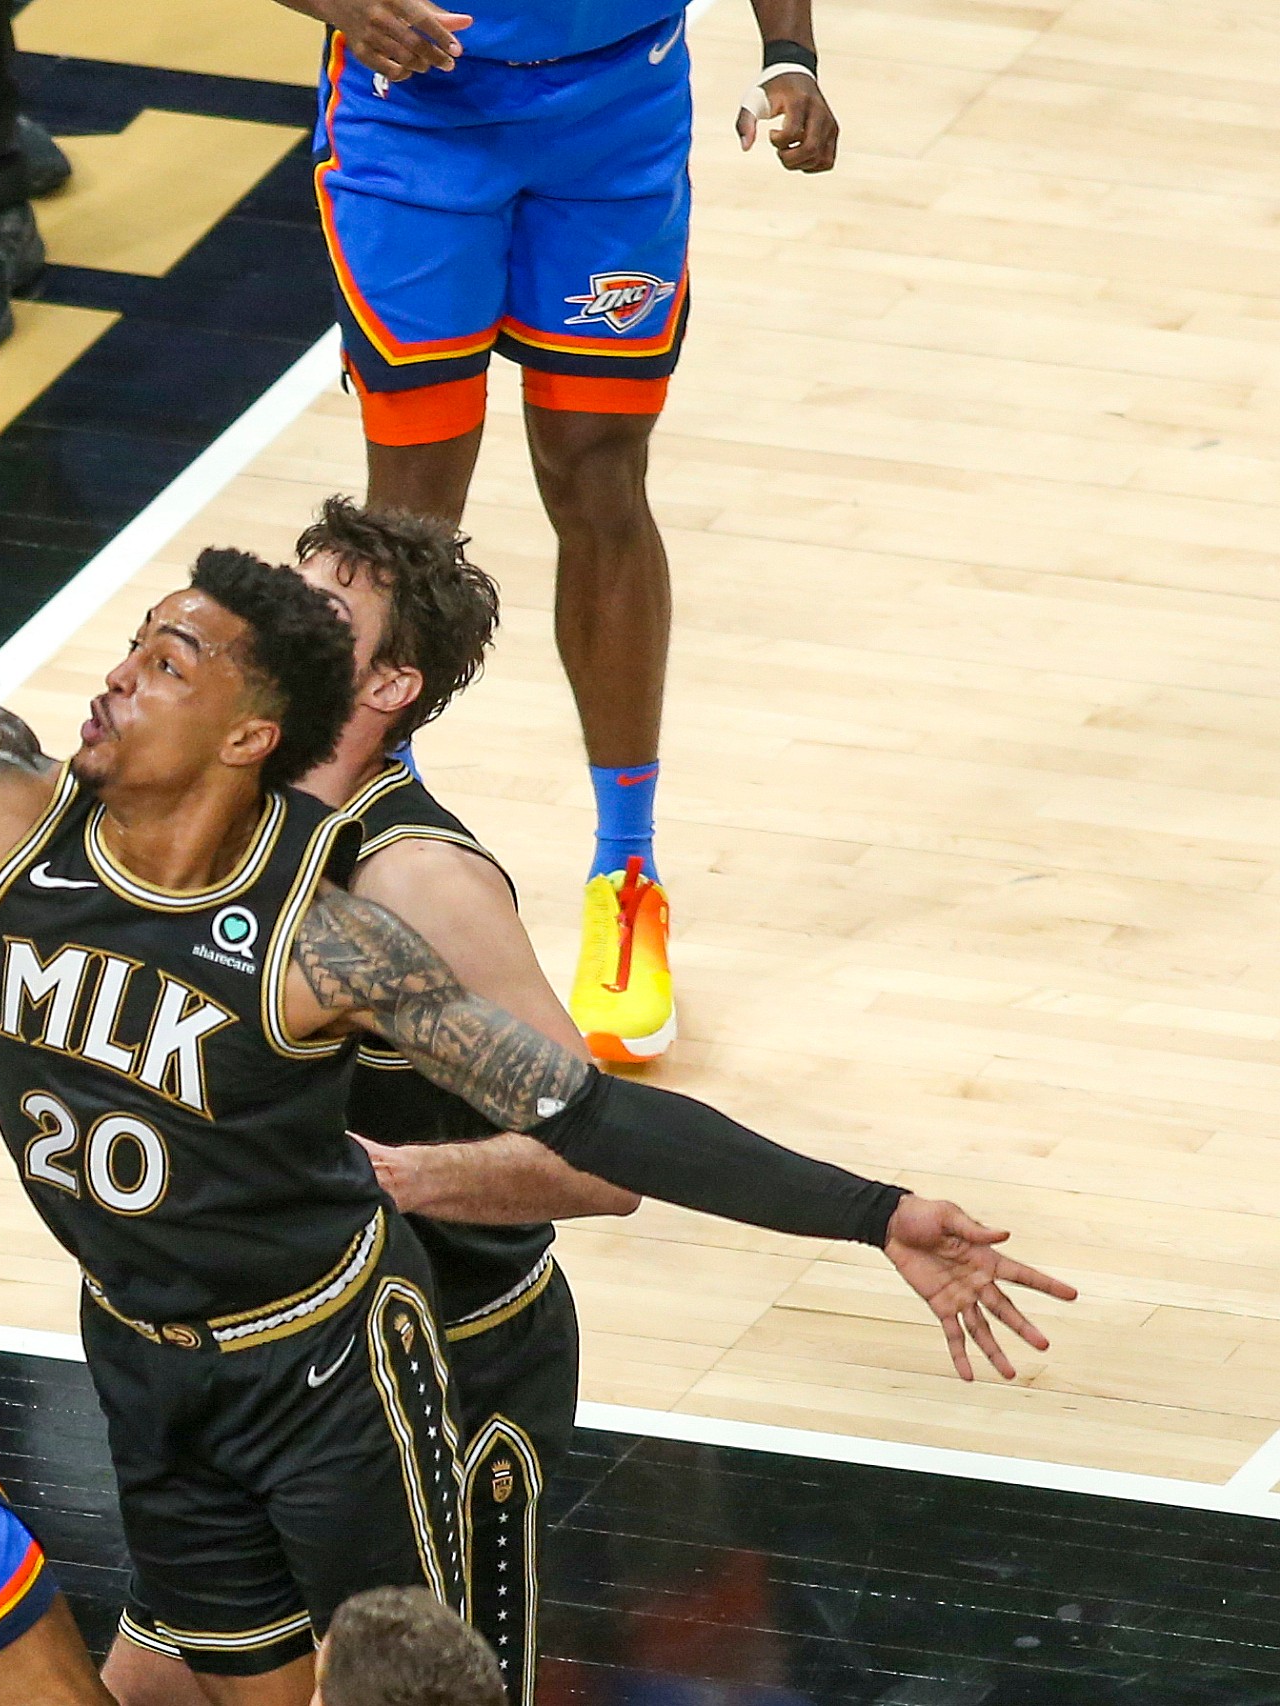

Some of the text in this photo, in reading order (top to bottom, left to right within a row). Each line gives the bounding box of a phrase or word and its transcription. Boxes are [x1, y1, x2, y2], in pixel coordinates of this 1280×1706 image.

[586, 285, 648, 314] OKC
[192, 944, 257, 975] sharecare
[20, 1089, 170, 1217] 20
